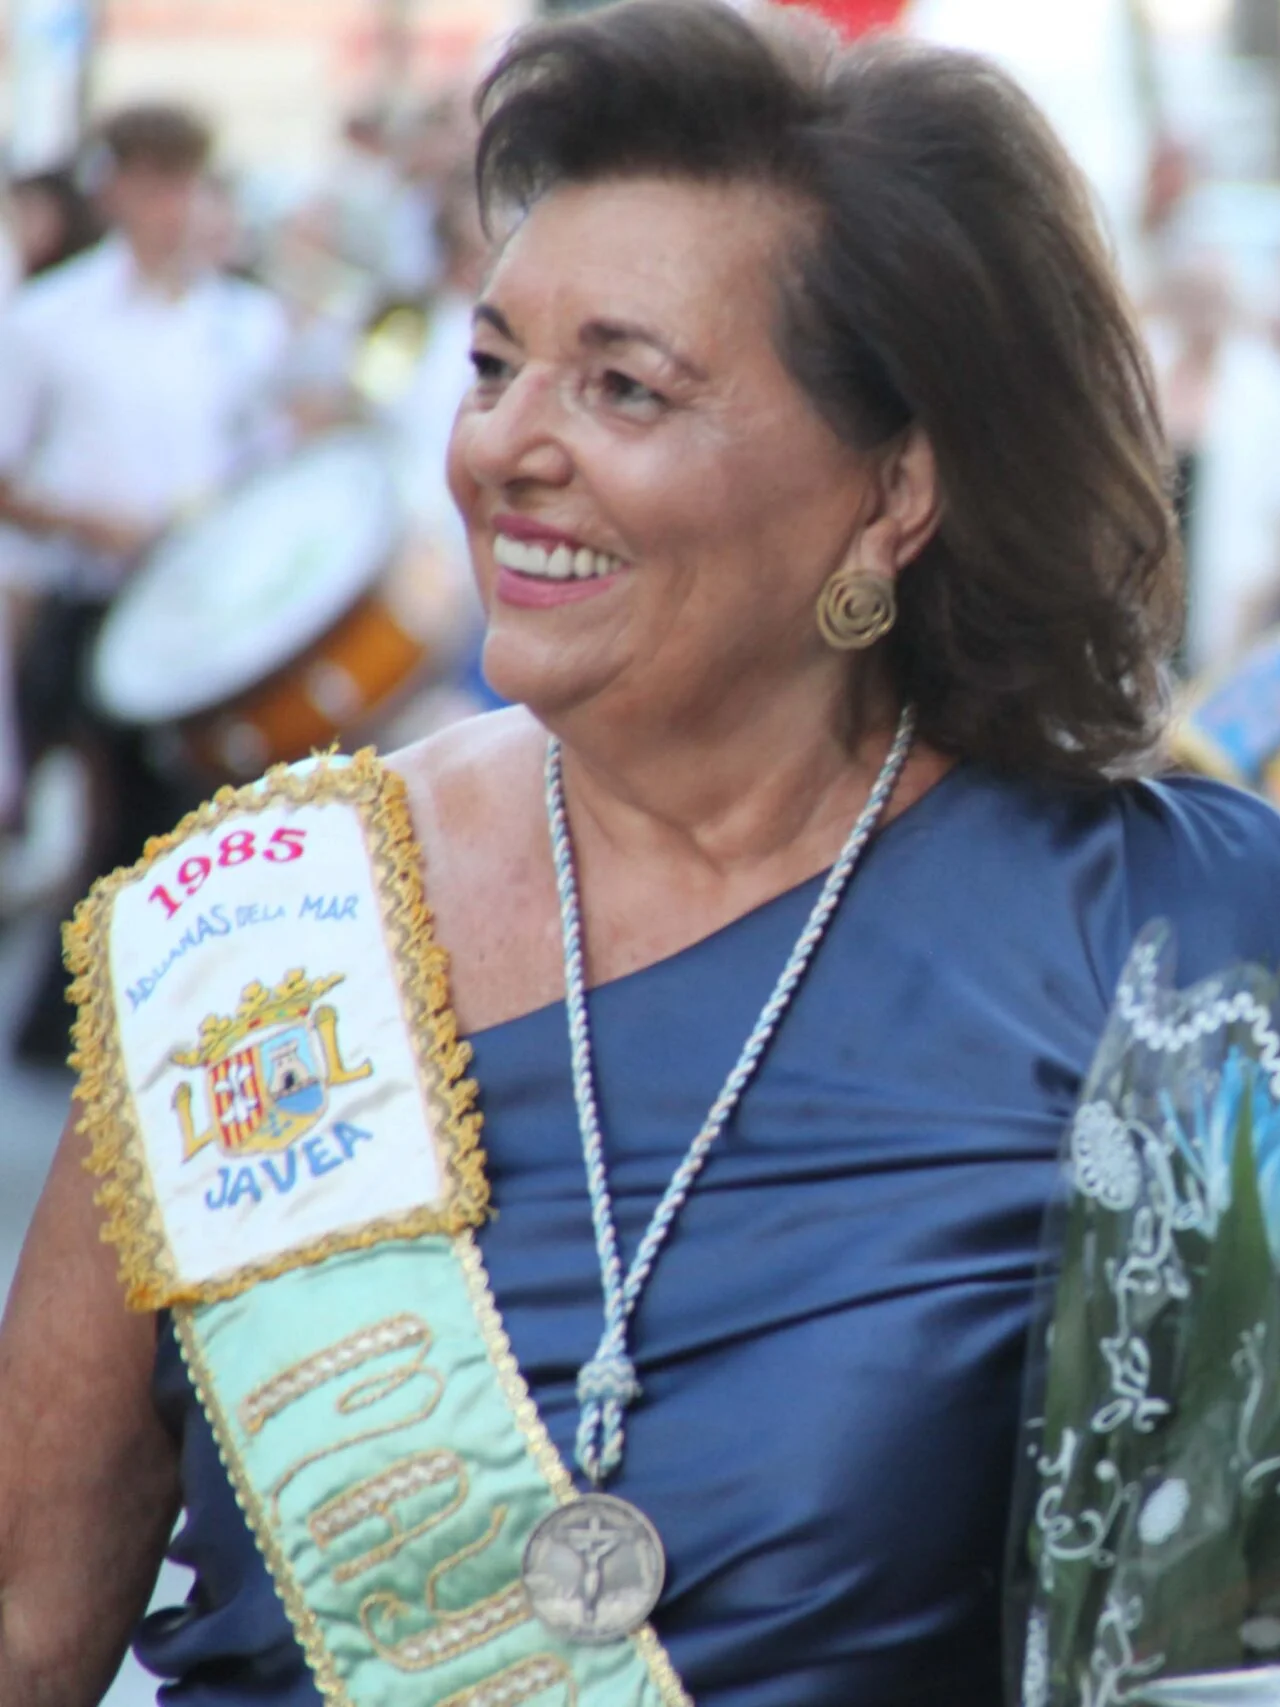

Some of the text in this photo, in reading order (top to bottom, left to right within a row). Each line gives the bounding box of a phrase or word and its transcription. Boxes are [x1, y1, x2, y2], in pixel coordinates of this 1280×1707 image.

[148, 827, 308, 919] 1985
[298, 893, 361, 922] MAR
[204, 1120, 373, 1211] JAVEA
